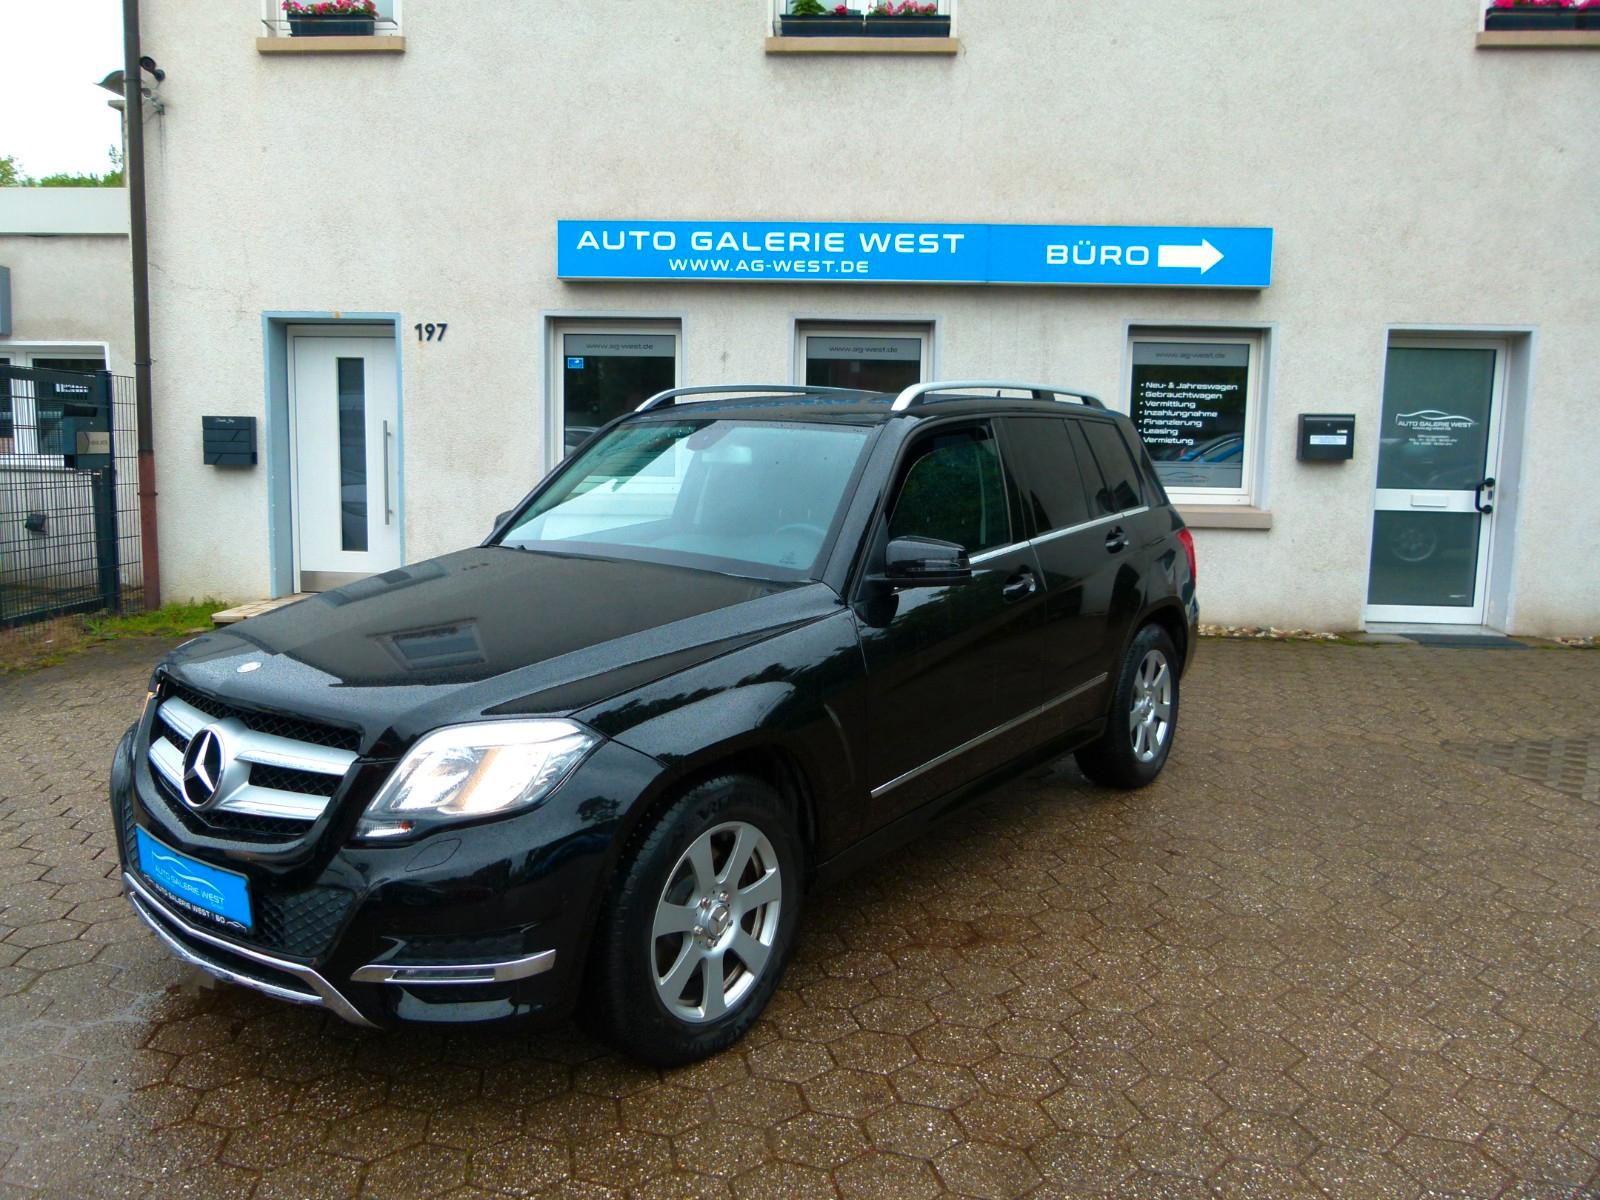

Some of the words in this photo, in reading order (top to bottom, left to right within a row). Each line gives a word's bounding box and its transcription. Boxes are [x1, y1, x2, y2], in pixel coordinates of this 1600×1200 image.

[576, 230, 676, 251] AUTO
[690, 231, 845, 253] GALERIE
[859, 232, 965, 254] WEST
[1046, 240, 1150, 266] BÜRO
[669, 258, 869, 273] WWW.AG-WEST.DE
[414, 322, 448, 342] 197
[1176, 382, 1238, 391] Jahreswagen
[1145, 391, 1222, 400] Gebrauchtwagen
[1145, 400, 1196, 409] Vermittlung
[1144, 409, 1218, 418] Inzahlungnahme
[1143, 419, 1203, 427] Finanzierung
[1143, 428, 1179, 436] Leasing
[1143, 436, 1194, 445] Vermietung
[155, 866, 172, 881] AUTO
[171, 875, 200, 896] GALERIE
[201, 890, 225, 905] WEST
[191, 904, 210, 918] WEST
